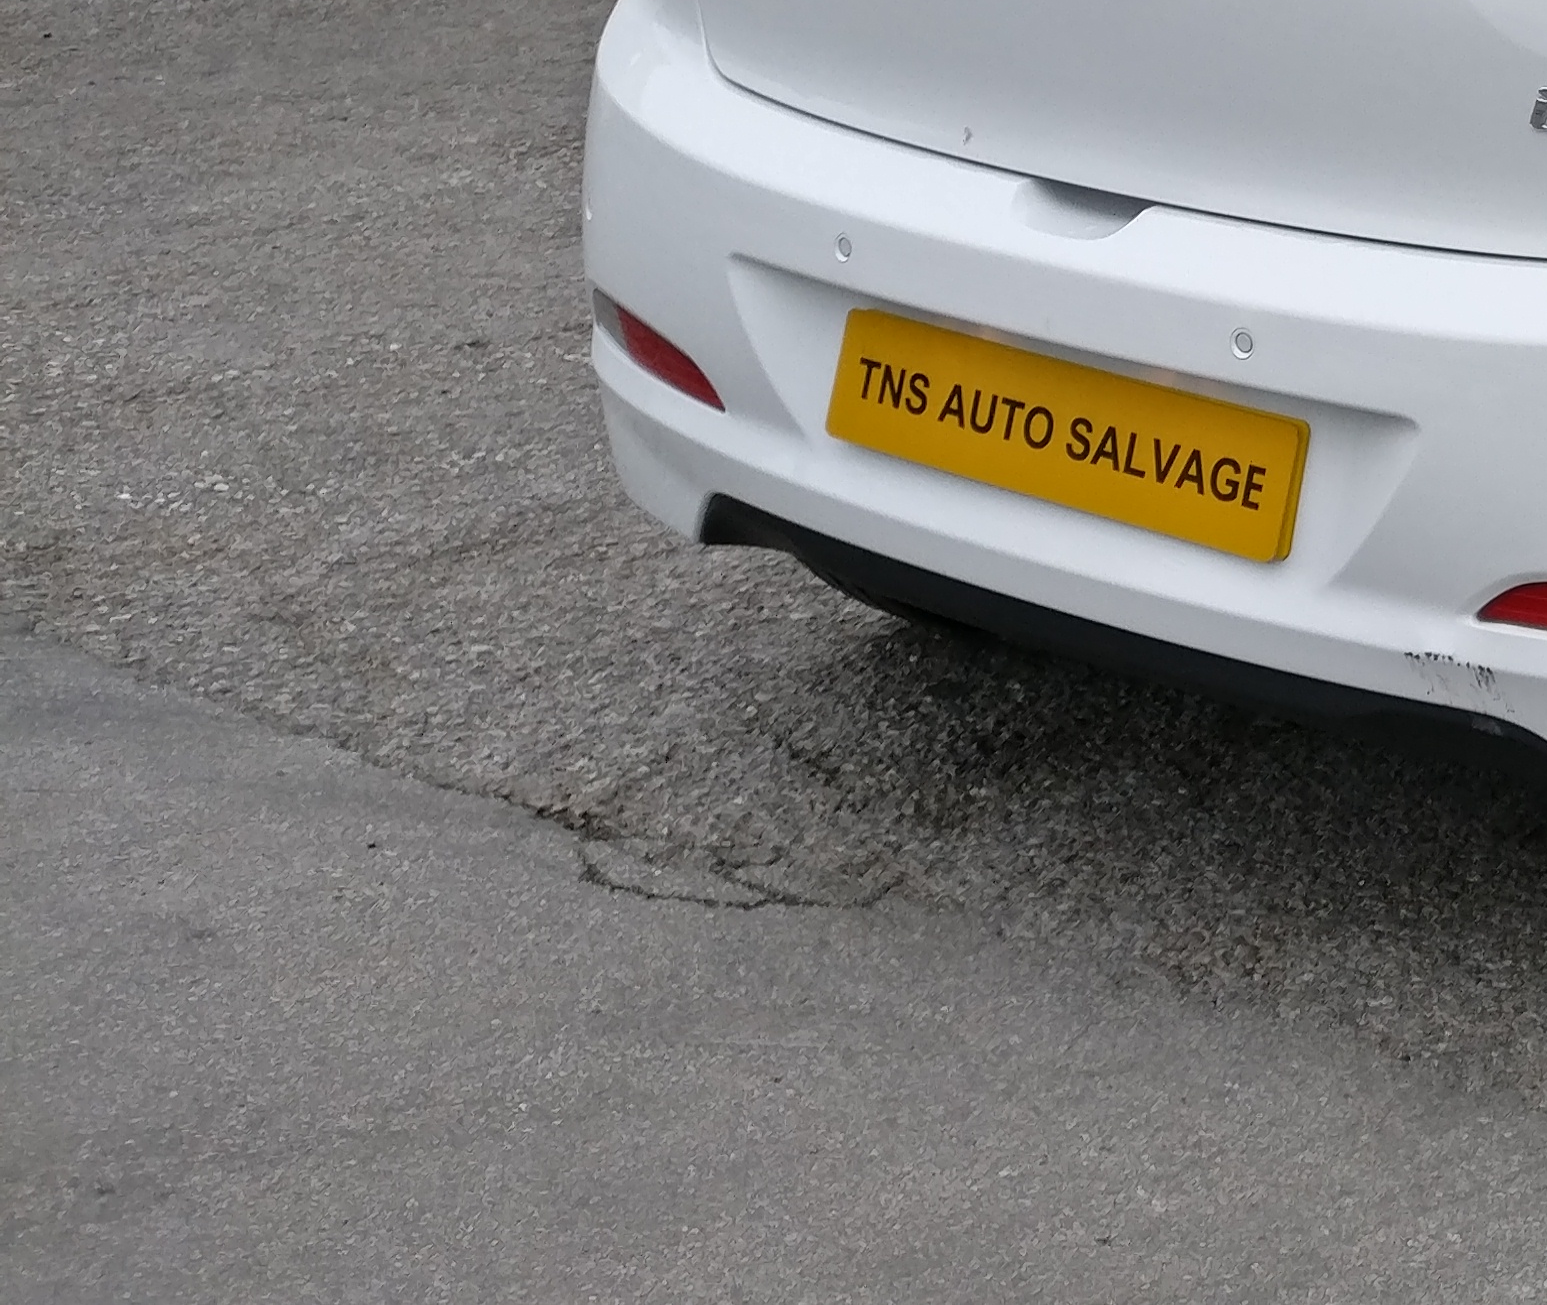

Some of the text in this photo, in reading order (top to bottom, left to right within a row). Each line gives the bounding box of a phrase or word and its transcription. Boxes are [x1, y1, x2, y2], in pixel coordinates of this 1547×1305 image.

[859, 356, 1267, 511] TNS AUTO SALVAGE
